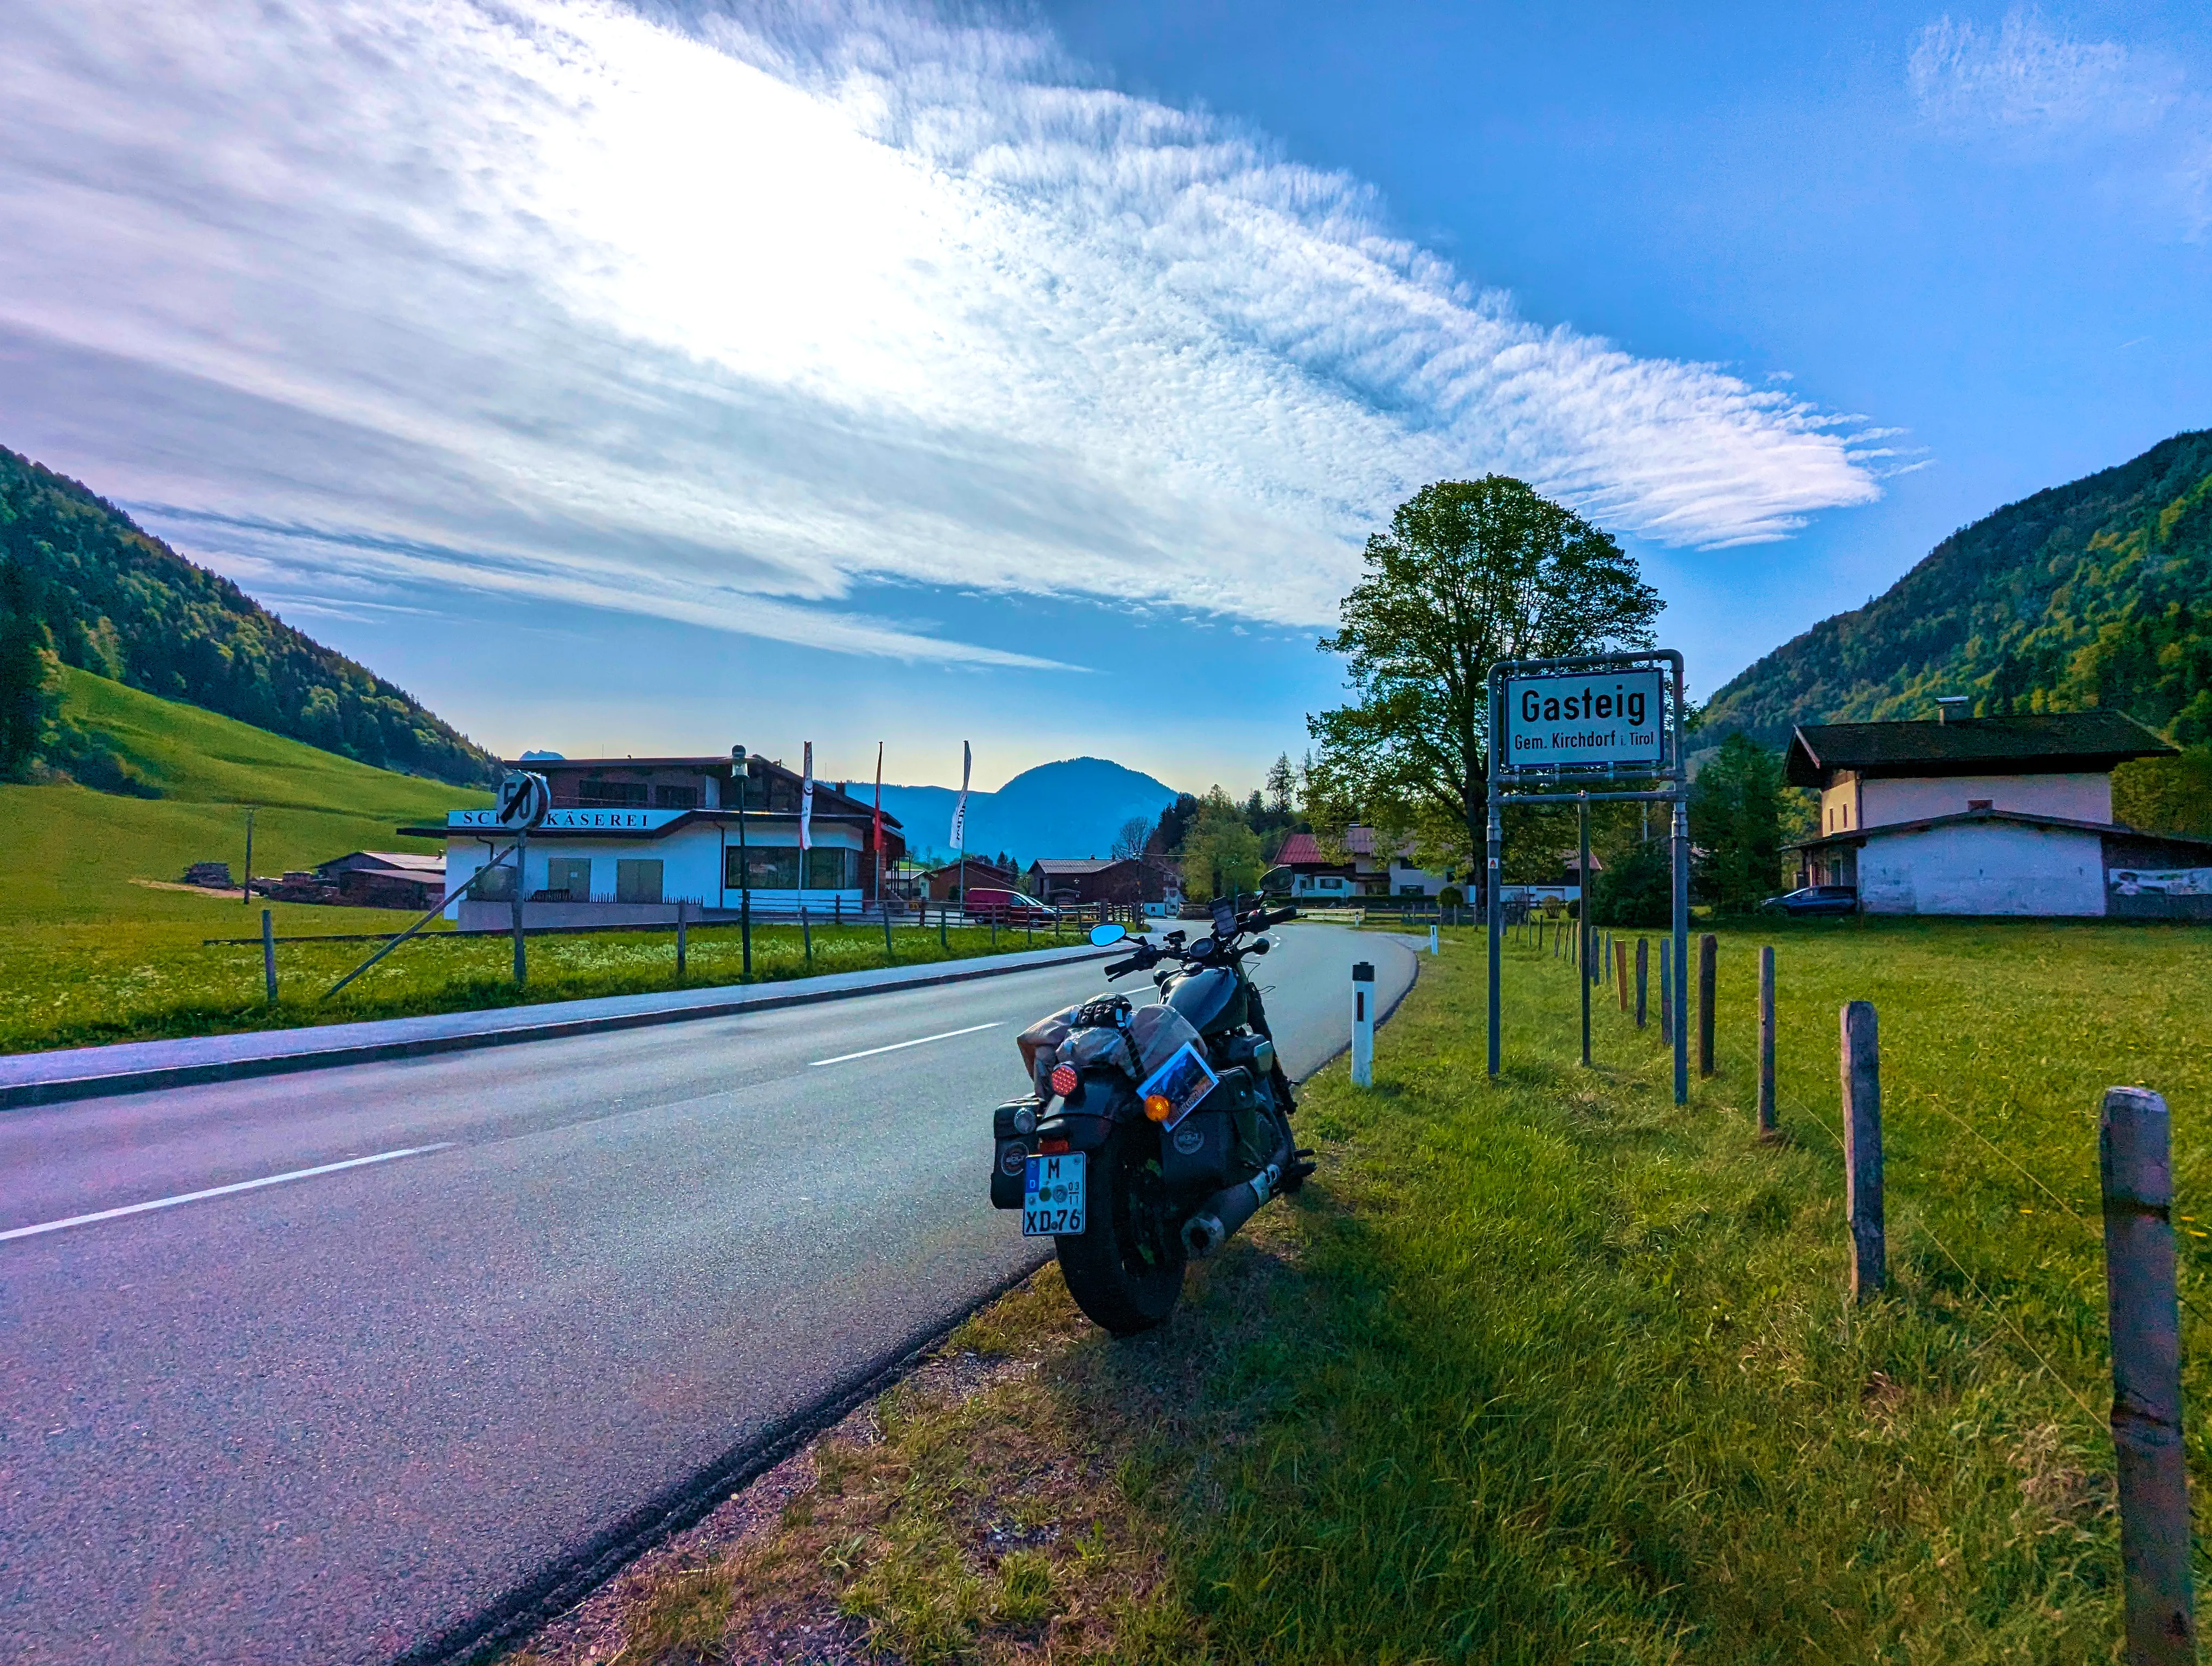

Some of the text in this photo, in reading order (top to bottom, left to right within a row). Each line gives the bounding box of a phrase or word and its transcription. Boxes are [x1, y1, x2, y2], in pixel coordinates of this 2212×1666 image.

[1522, 684, 1645, 726] Gasteig
[1515, 734, 1547, 750] Gem.
[1553, 731, 1616, 748] Kirchdorf
[1629, 732, 1654, 746] Tirol
[504, 782, 531, 819] 50
[1048, 1158, 1059, 1178] M
[1068, 1182, 1079, 1190] 03
